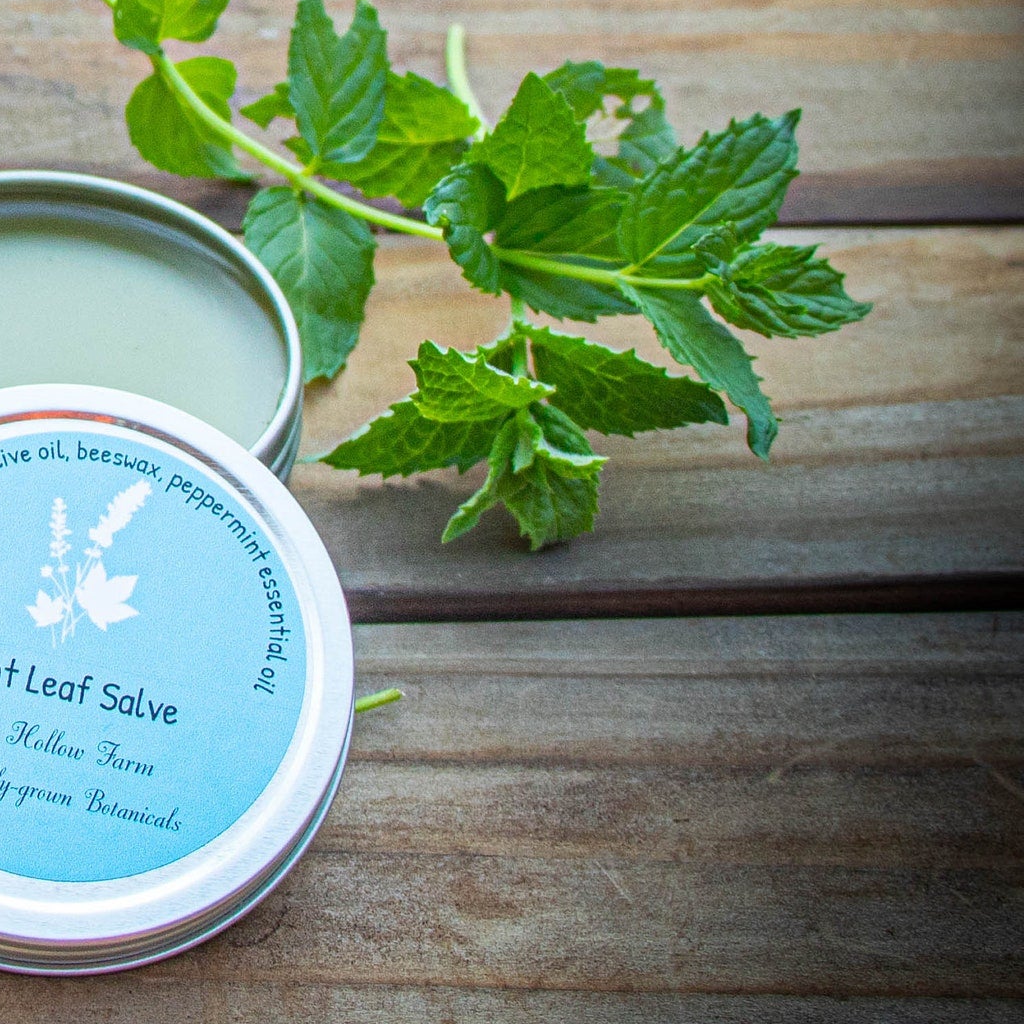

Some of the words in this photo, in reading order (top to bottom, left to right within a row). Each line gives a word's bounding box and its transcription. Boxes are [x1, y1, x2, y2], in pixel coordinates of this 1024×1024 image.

[37, 440, 70, 463] oil,
[76, 440, 164, 482] beeswax,
[165, 473, 270, 562] peppermint
[258, 566, 291, 662] essential
[25, 665, 94, 705] Leaf
[99, 683, 178, 724] Salve
[254, 666, 275, 695] oil
[6, 721, 84, 761] Hollow
[97, 740, 154, 777] Farm
[84, 788, 183, 832] Botanicals
